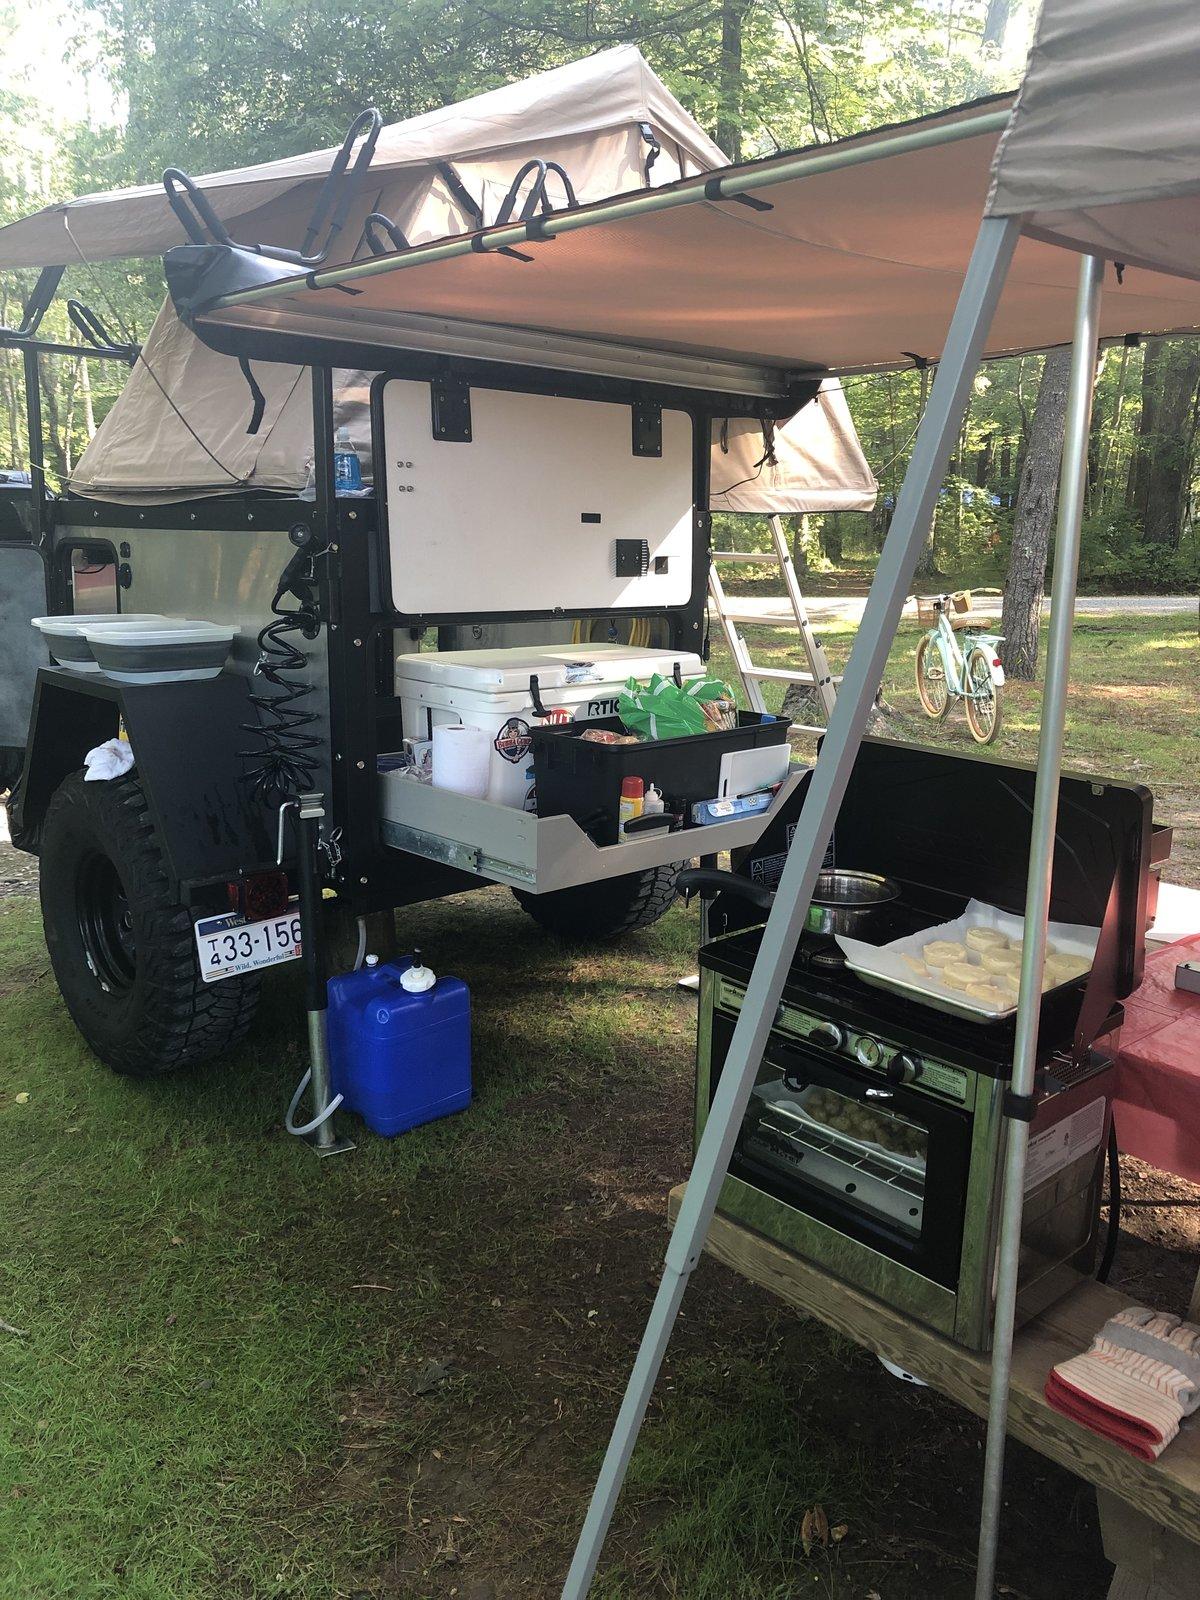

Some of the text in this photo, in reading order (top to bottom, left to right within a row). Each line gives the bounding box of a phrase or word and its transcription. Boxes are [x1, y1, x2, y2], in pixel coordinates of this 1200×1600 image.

[225, 915, 247, 927] West
[223, 919, 301, 961] 33-156
[235, 953, 285, 971] Wild, Wonderful
